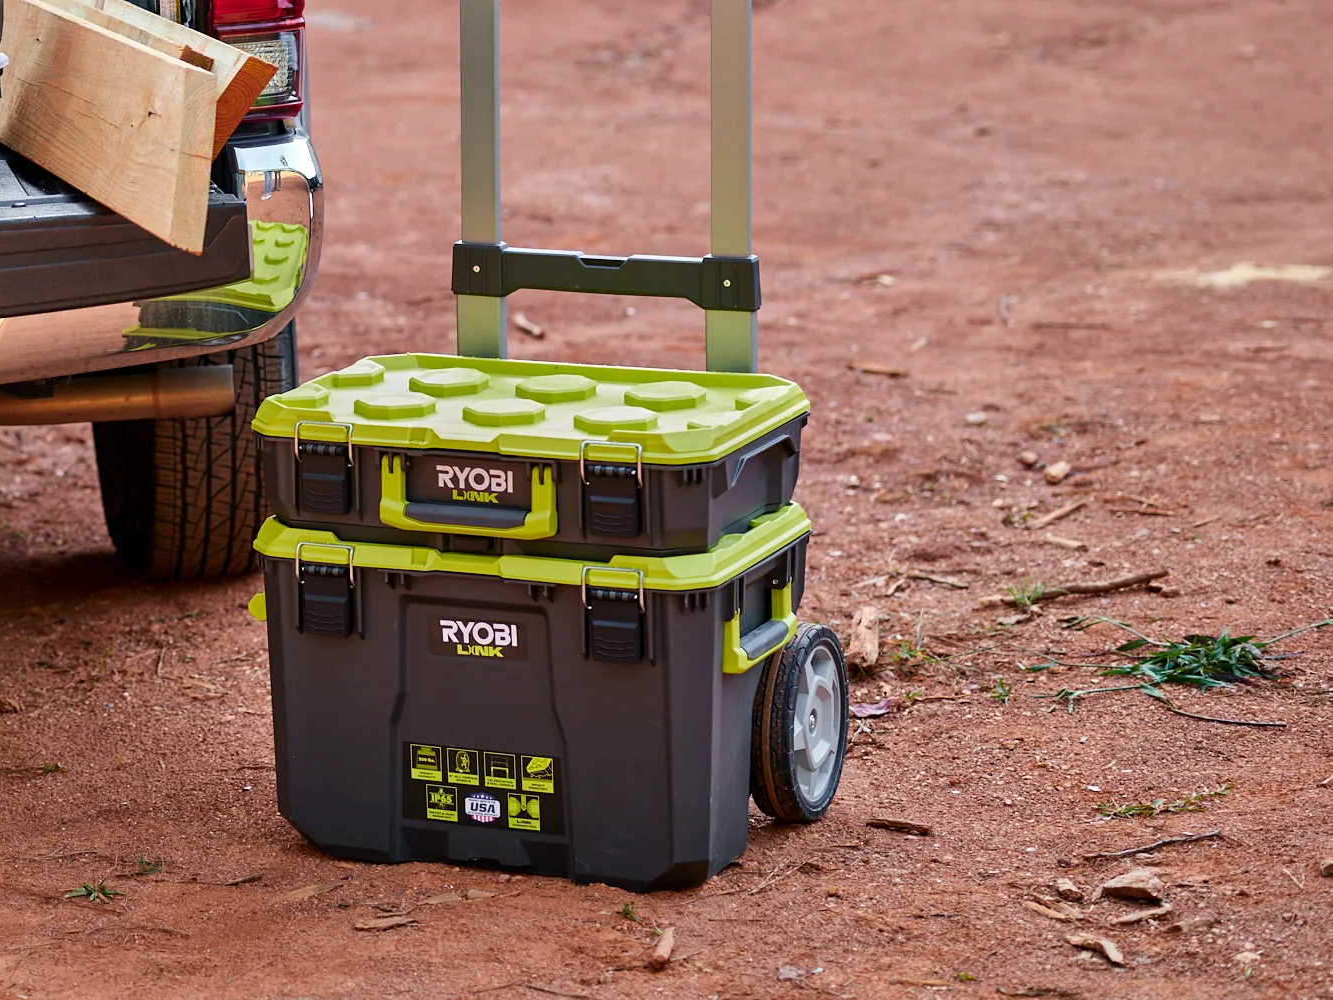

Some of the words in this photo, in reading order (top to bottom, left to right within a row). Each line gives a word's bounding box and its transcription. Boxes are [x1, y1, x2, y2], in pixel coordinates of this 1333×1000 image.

[436, 465, 514, 493] RYOBI
[439, 619, 518, 647] RYOBI
[431, 793, 453, 804] IP65
[470, 802, 496, 814] USA
